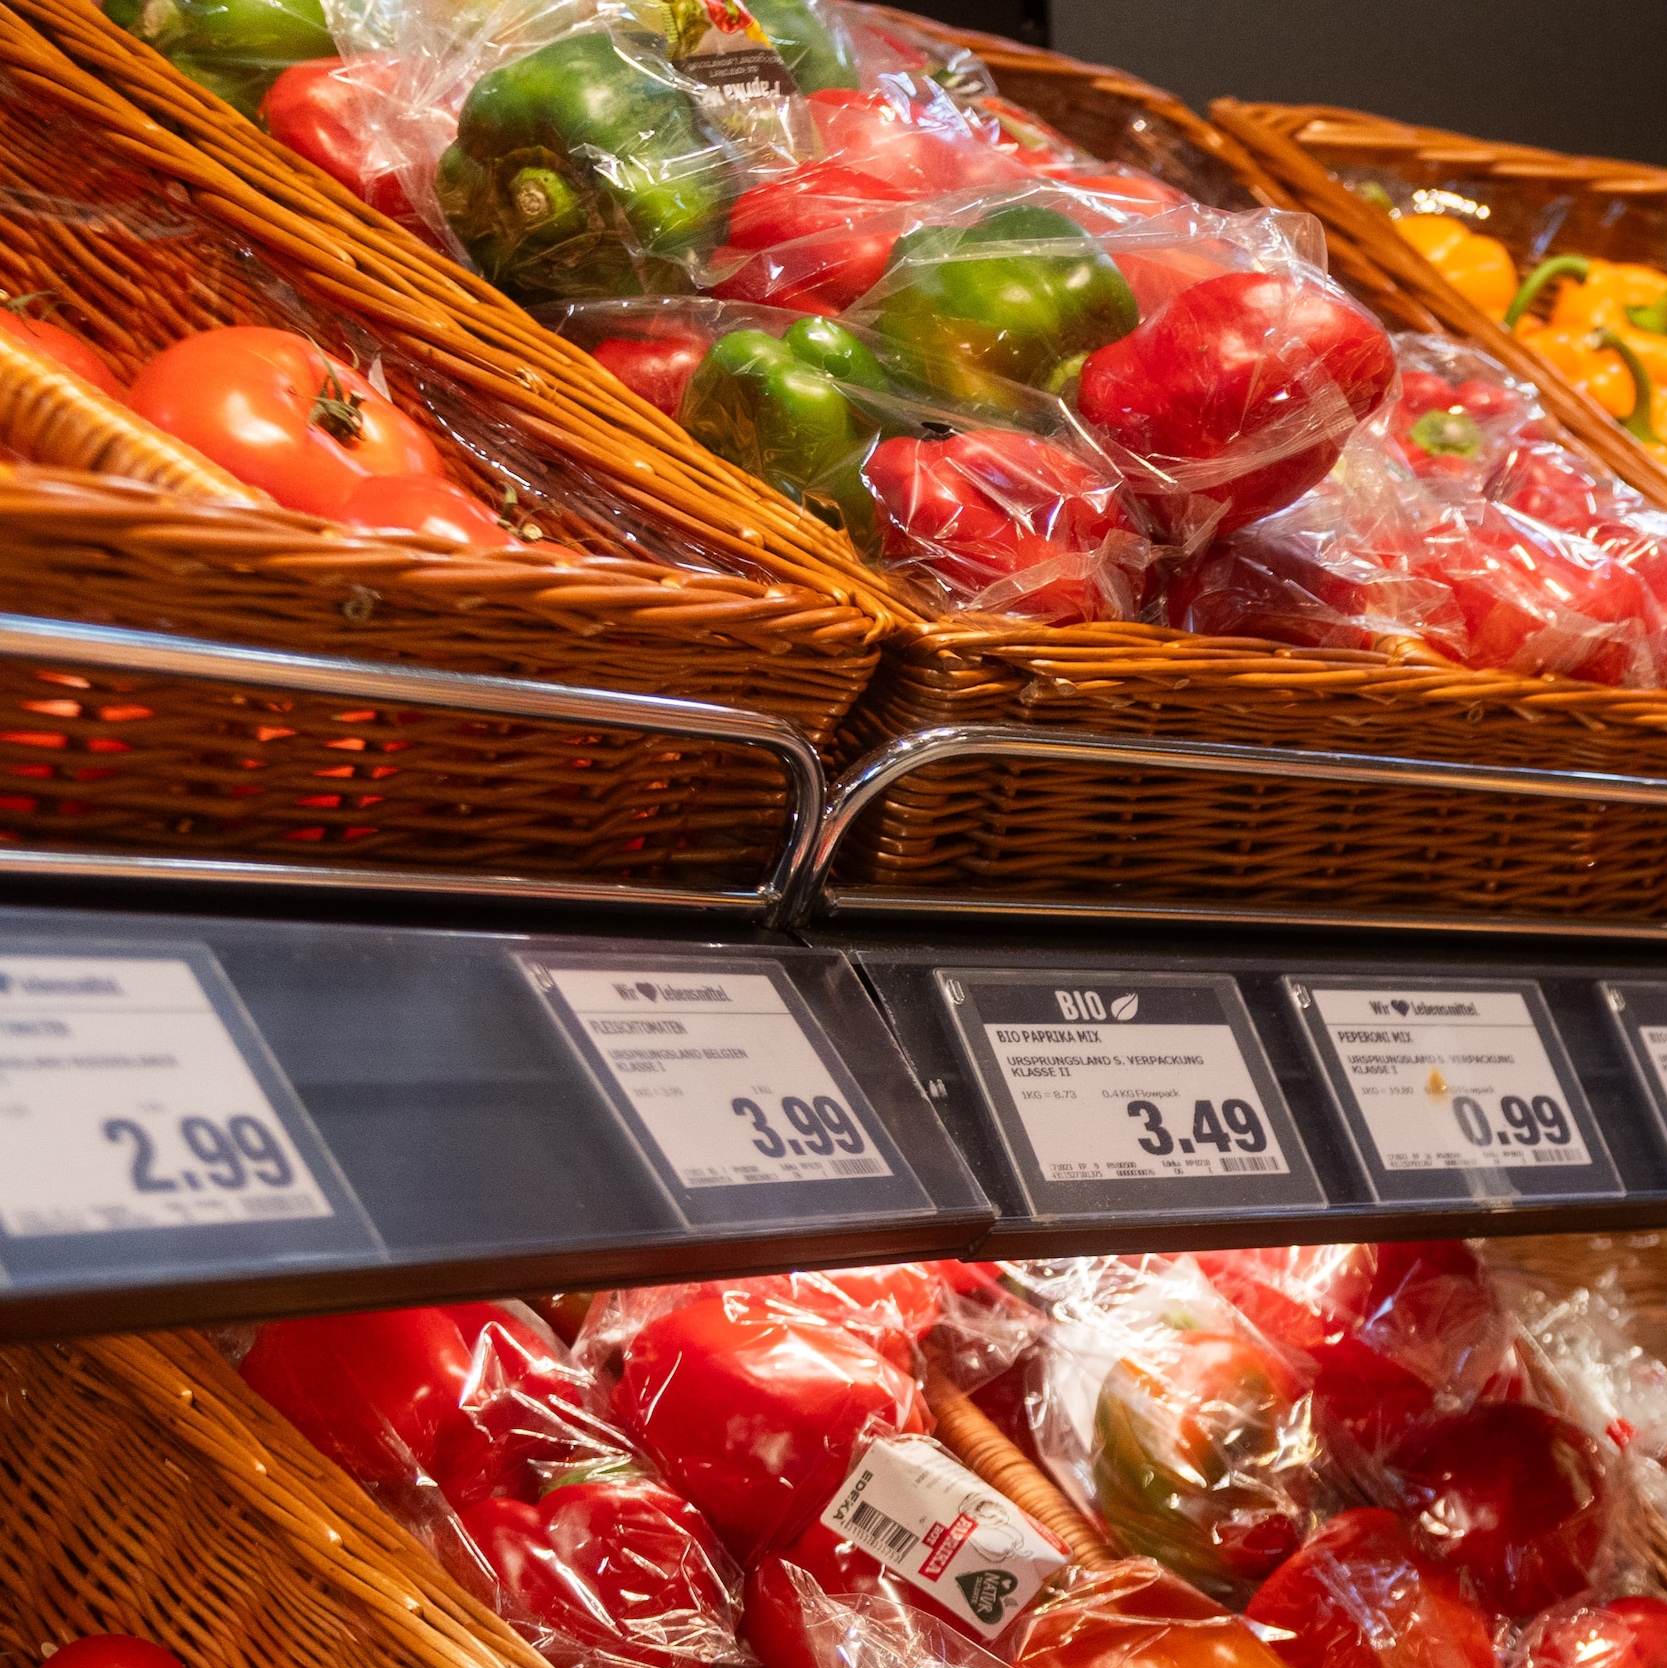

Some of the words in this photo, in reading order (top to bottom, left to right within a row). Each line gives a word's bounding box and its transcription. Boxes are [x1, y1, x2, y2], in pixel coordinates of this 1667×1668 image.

[612, 983, 637, 1001] Wir
[1054, 990, 1108, 1021] BIO
[1369, 1000, 1390, 1016] Wir
[1411, 1001, 1481, 1017] Lebensmittel.
[588, 1019, 688, 1036] FLEISCHTOMATEN
[996, 1030, 1021, 1044] BIO
[1022, 1030, 1077, 1044] PAPRIKA
[1077, 1030, 1103, 1044] MIX
[1337, 1031, 1392, 1044] PEPERONI
[1391, 1031, 1414, 1044] MIX
[609, 1048, 703, 1061] URSPRUNGSLAND
[702, 1048, 749, 1060] BELGIEN
[1006, 1055, 1113, 1067] URSPRUNGSLAND
[1126, 1055, 1205, 1067] VERPACKUNG
[1347, 1054, 1437, 1065] URSPRUNGSLAND
[1449, 1054, 1516, 1065] VERPACKUNG
[615, 1061, 656, 1073] KLASSE
[1011, 1066, 1056, 1078] KLASSE
[1059, 1066, 1072, 1078] II
[1351, 1065, 1391, 1075] KLASSE
[1021, 1090, 1043, 1101] 1KG
[1053, 1090, 1078, 1100] 8.73
[730, 1095, 866, 1159] 3.99
[1126, 1097, 1268, 1156] 3.49
[1452, 1095, 1573, 1147] 0.99
[102, 1113, 294, 1195] 2.99
[832, 1469, 874, 1522] EDEKA
[975, 1571, 1001, 1614] NATUR
